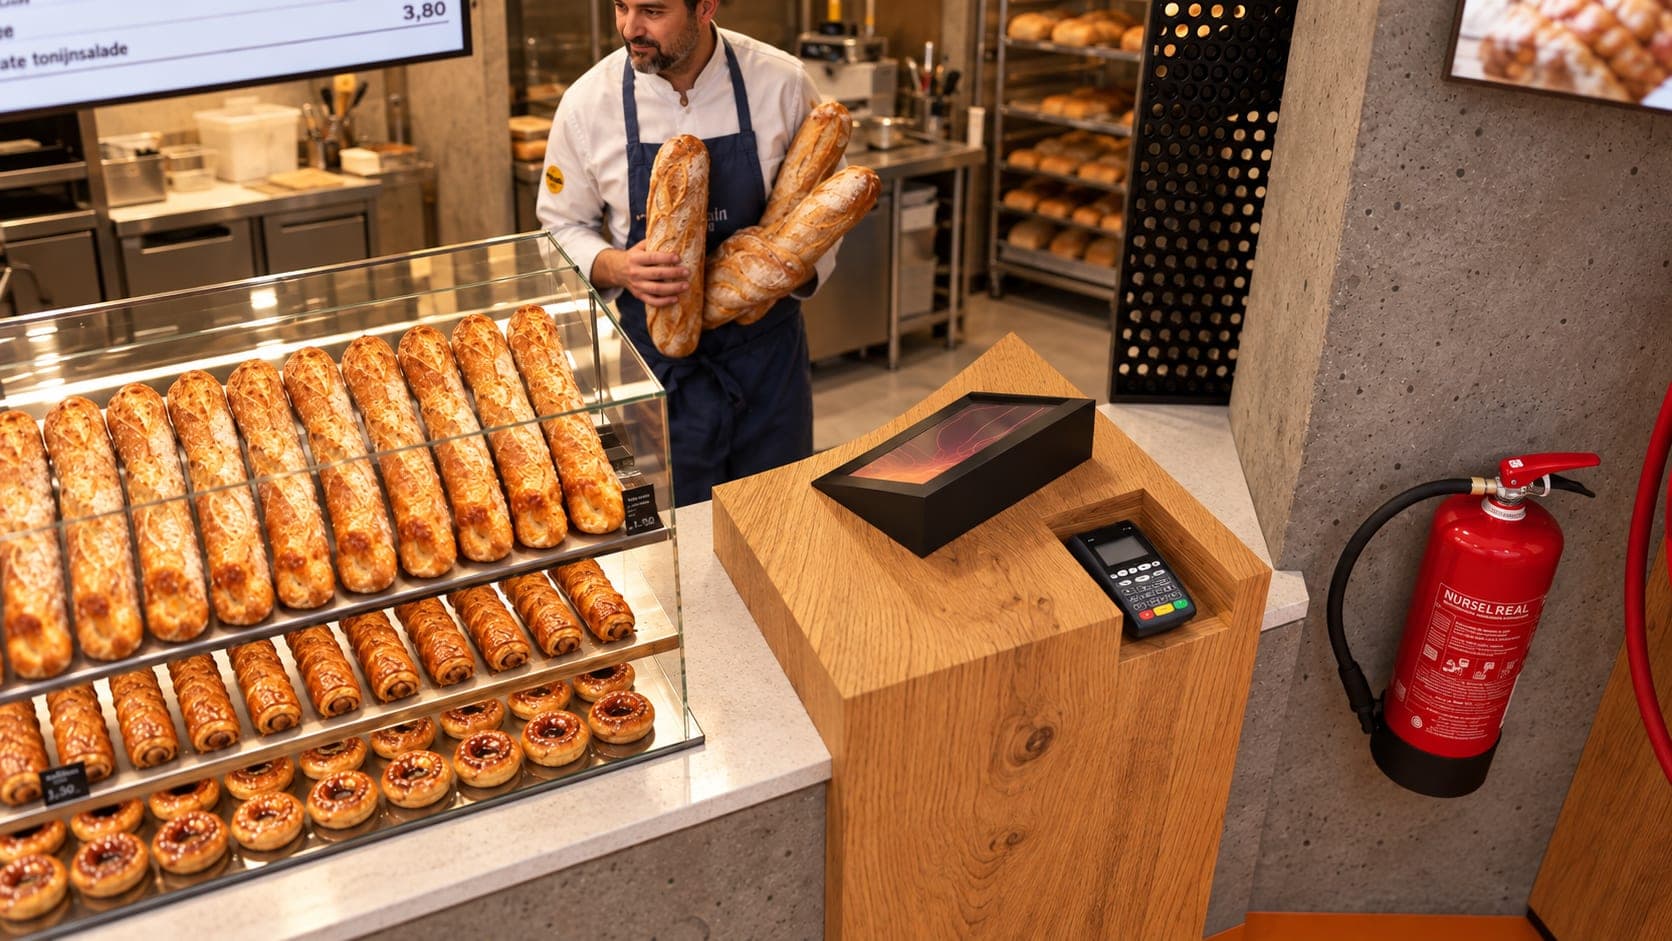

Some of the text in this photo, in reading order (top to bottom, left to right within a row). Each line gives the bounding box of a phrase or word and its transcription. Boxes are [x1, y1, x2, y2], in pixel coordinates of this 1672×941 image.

[403, 1, 446, 21] 3,80
[32, 41, 128, 66] tonijnsalade
[1444, 589, 1493, 615] NURSEL
[1495, 604, 1529, 616] REAL
